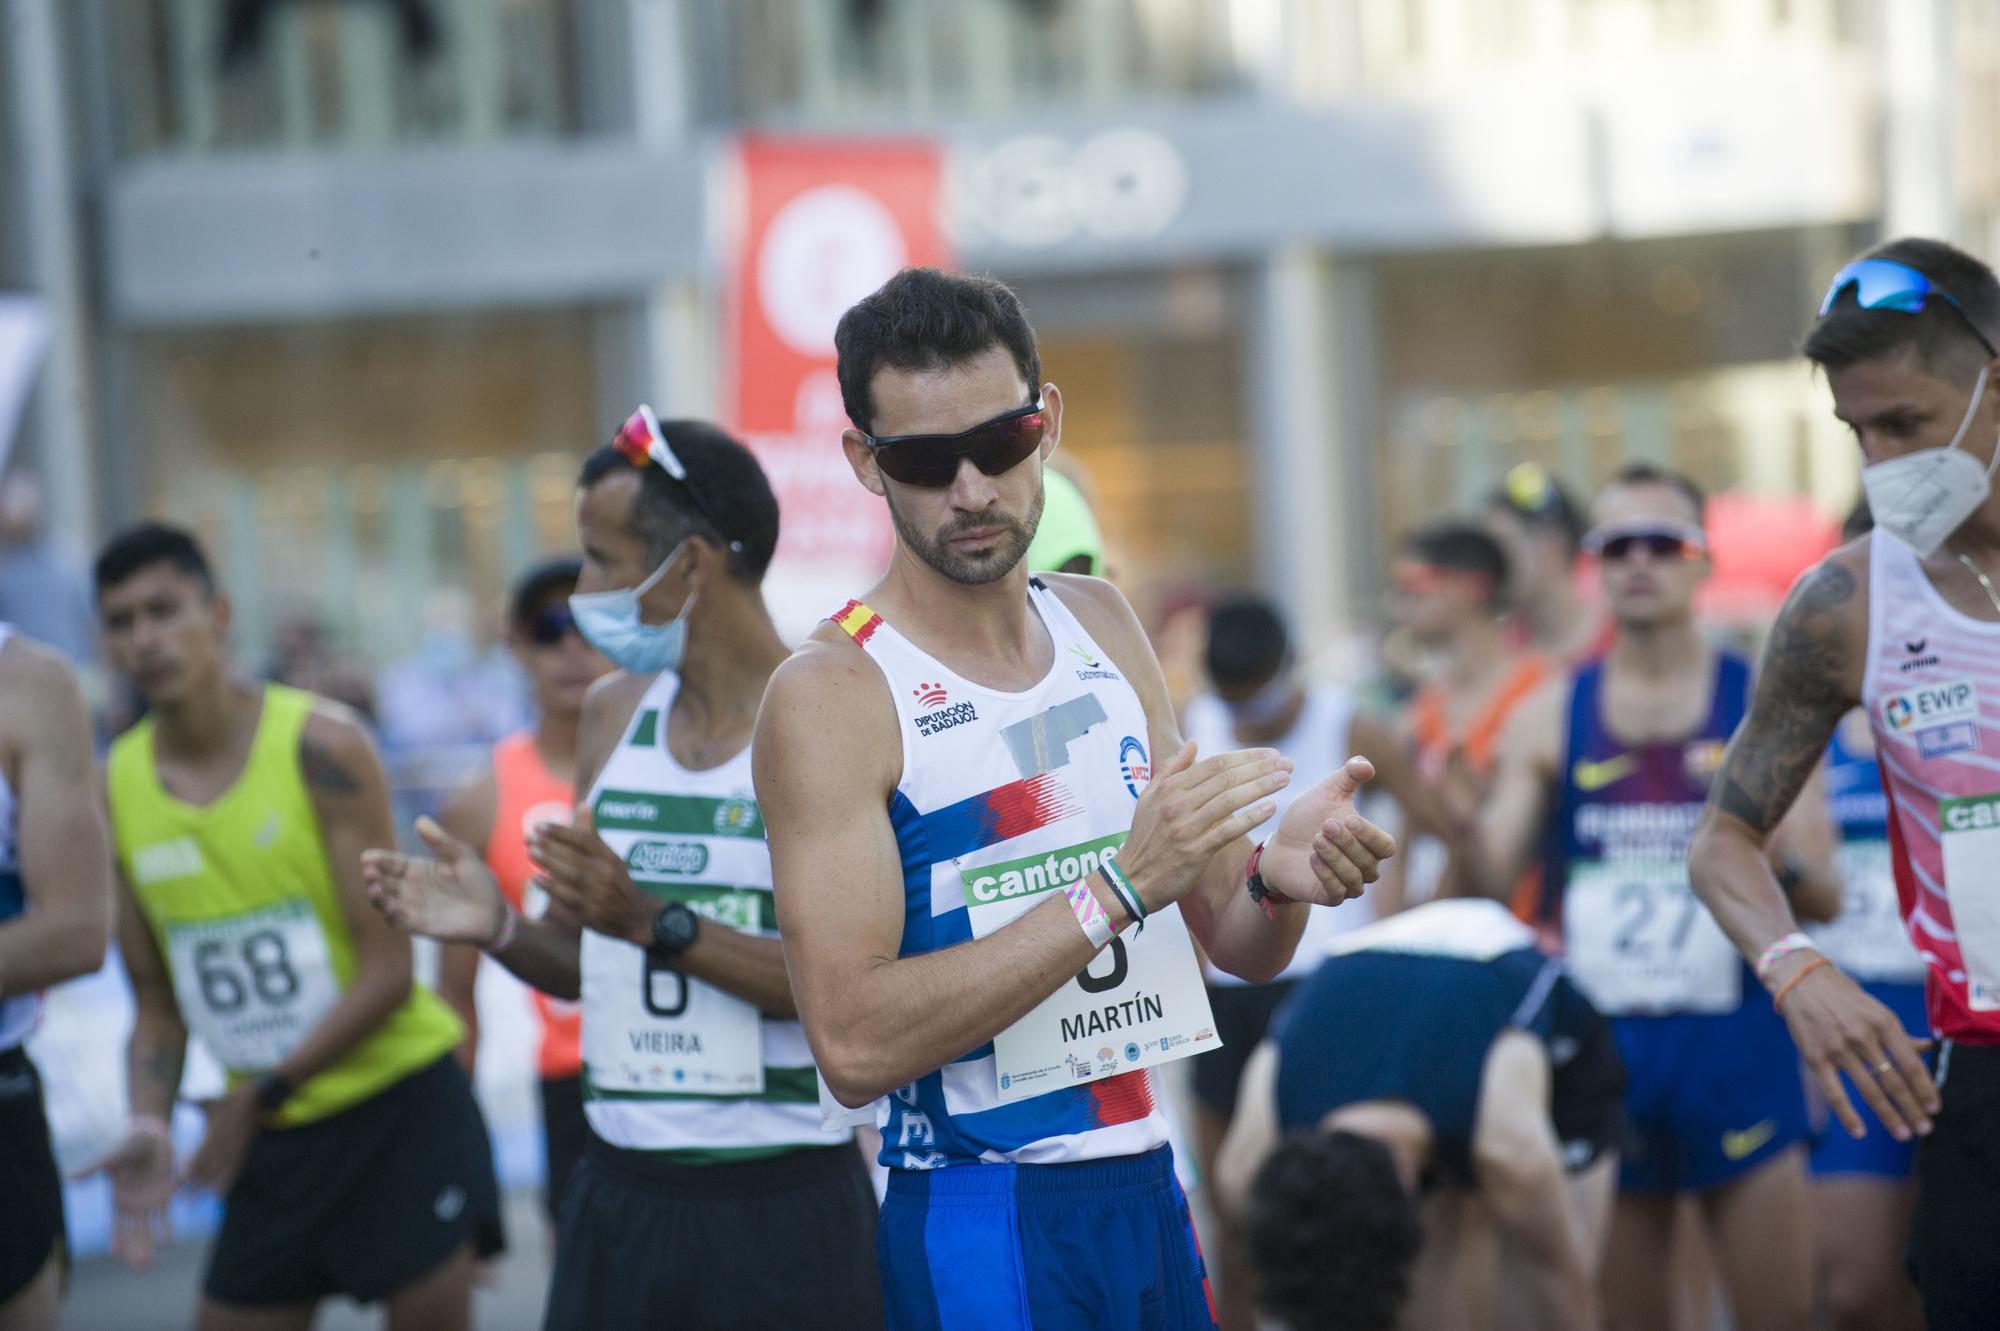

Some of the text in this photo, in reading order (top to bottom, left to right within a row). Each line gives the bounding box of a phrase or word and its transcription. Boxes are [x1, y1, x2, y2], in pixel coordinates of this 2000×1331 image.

[914, 700, 975, 728] DIPUTACIÓN
[1917, 682, 1971, 716] EWP
[931, 709, 979, 734] BADAJOZ
[972, 842, 1126, 901] cantone
[1613, 882, 1698, 960] 27
[194, 931, 299, 1014] 68
[1060, 991, 1164, 1043] MARTÍN
[628, 1031, 703, 1055] VIEIRA
